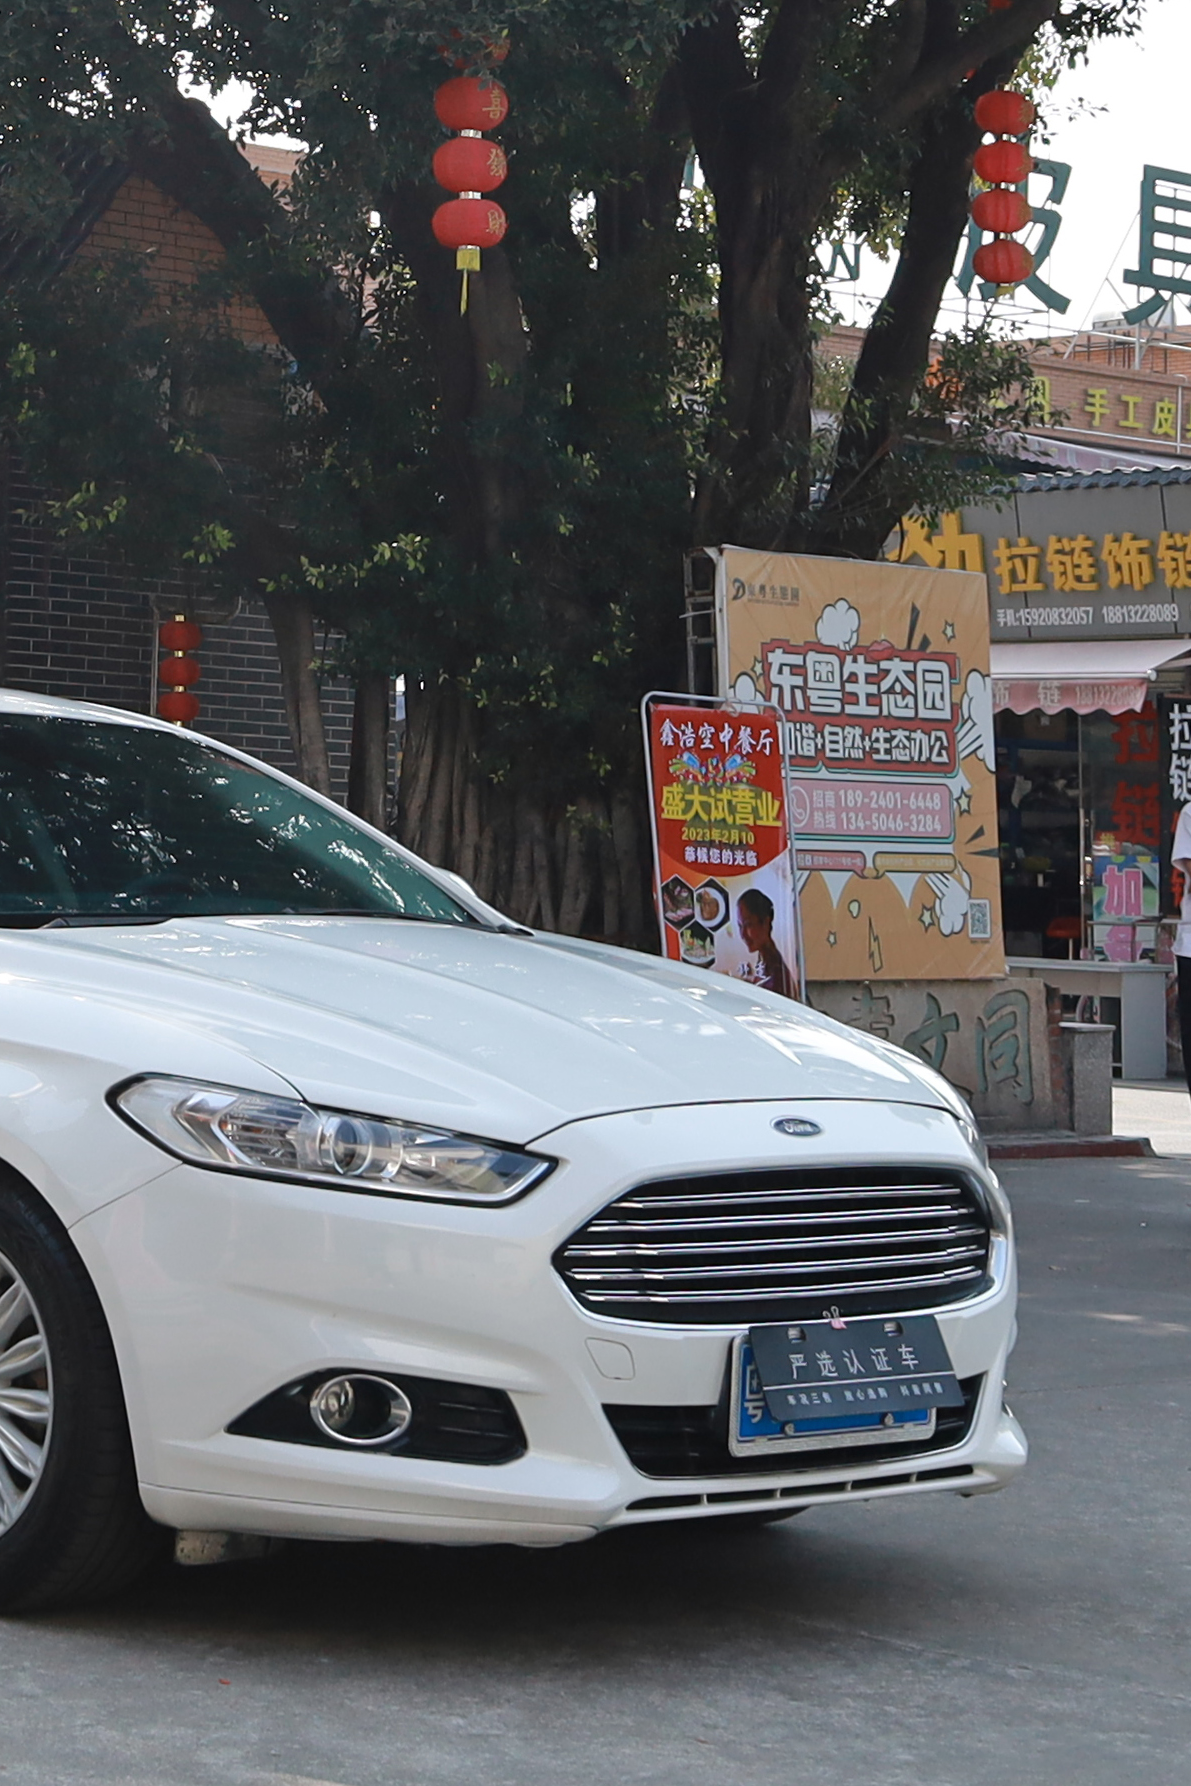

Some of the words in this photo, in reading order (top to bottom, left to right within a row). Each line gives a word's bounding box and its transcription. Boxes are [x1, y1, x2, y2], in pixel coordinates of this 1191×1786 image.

[1084, 388, 1191, 438] 手工皮
[1101, 603, 1179, 624] 18813228089
[767, 648, 952, 720] 东粤生态园
[661, 782, 783, 827] 盛大试营业
[839, 789, 941, 810] 189-2401-6448
[841, 811, 941, 832] 134-5046-3284
[684, 845, 758, 868] 恭候您的光临
[788, 1343, 919, 1380] 严选认证车
